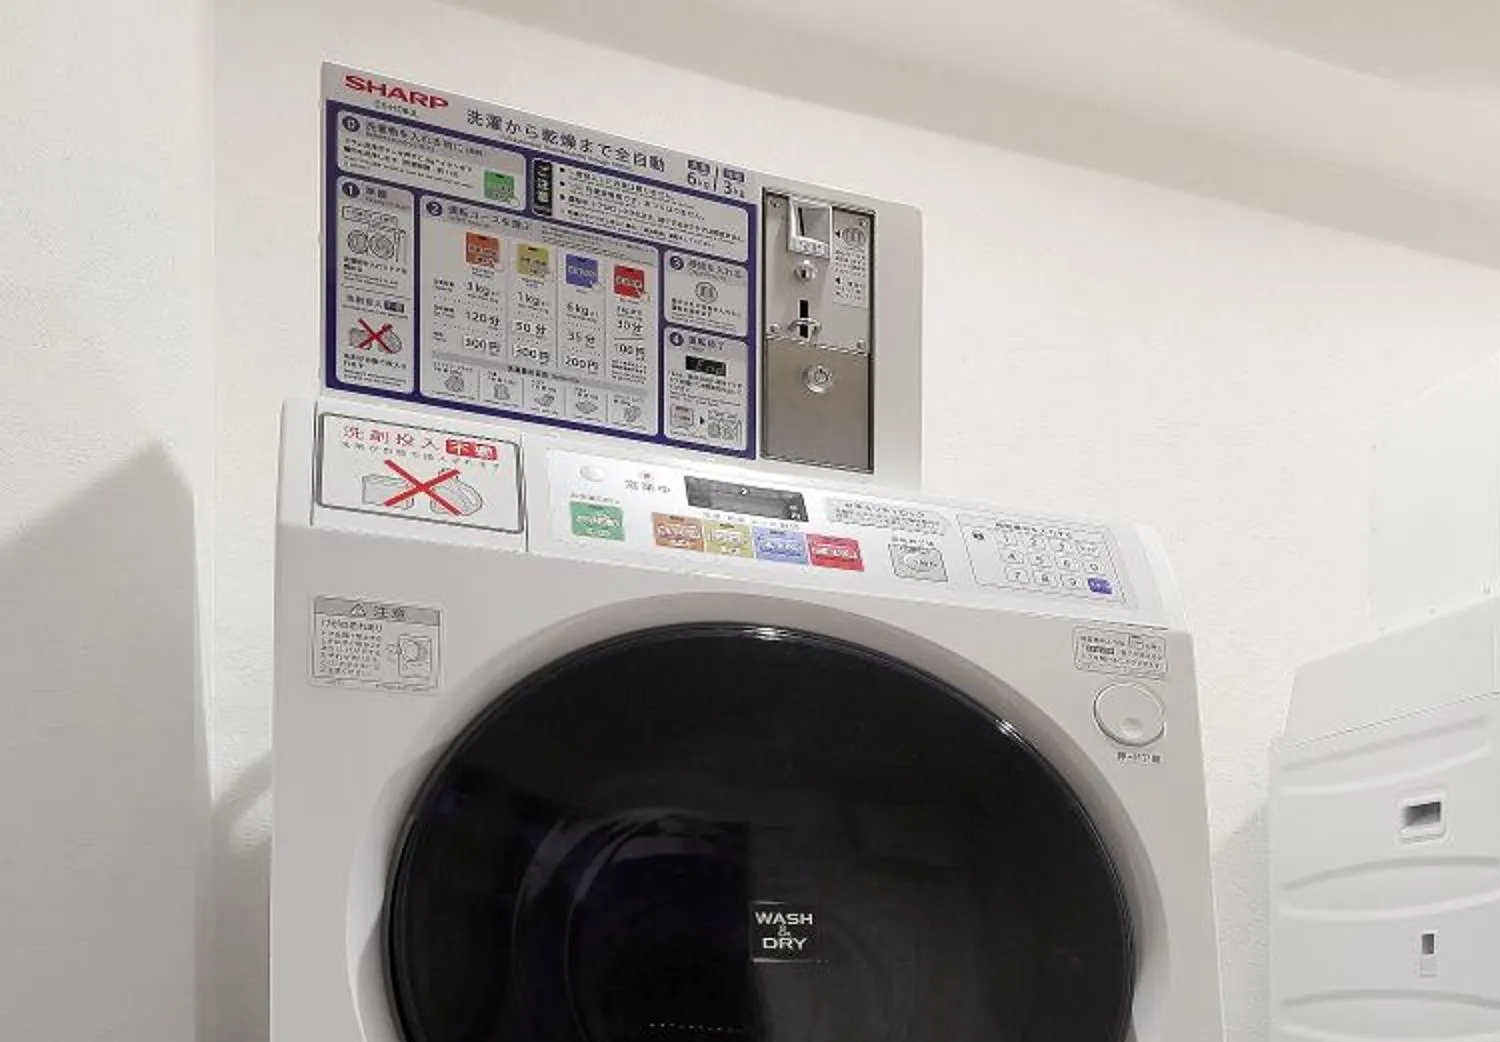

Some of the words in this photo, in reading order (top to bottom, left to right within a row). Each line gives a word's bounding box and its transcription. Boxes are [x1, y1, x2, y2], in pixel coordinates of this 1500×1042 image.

[345, 75, 449, 109] SHARP
[754, 911, 813, 925] WASH
[762, 937, 808, 950] DRY
